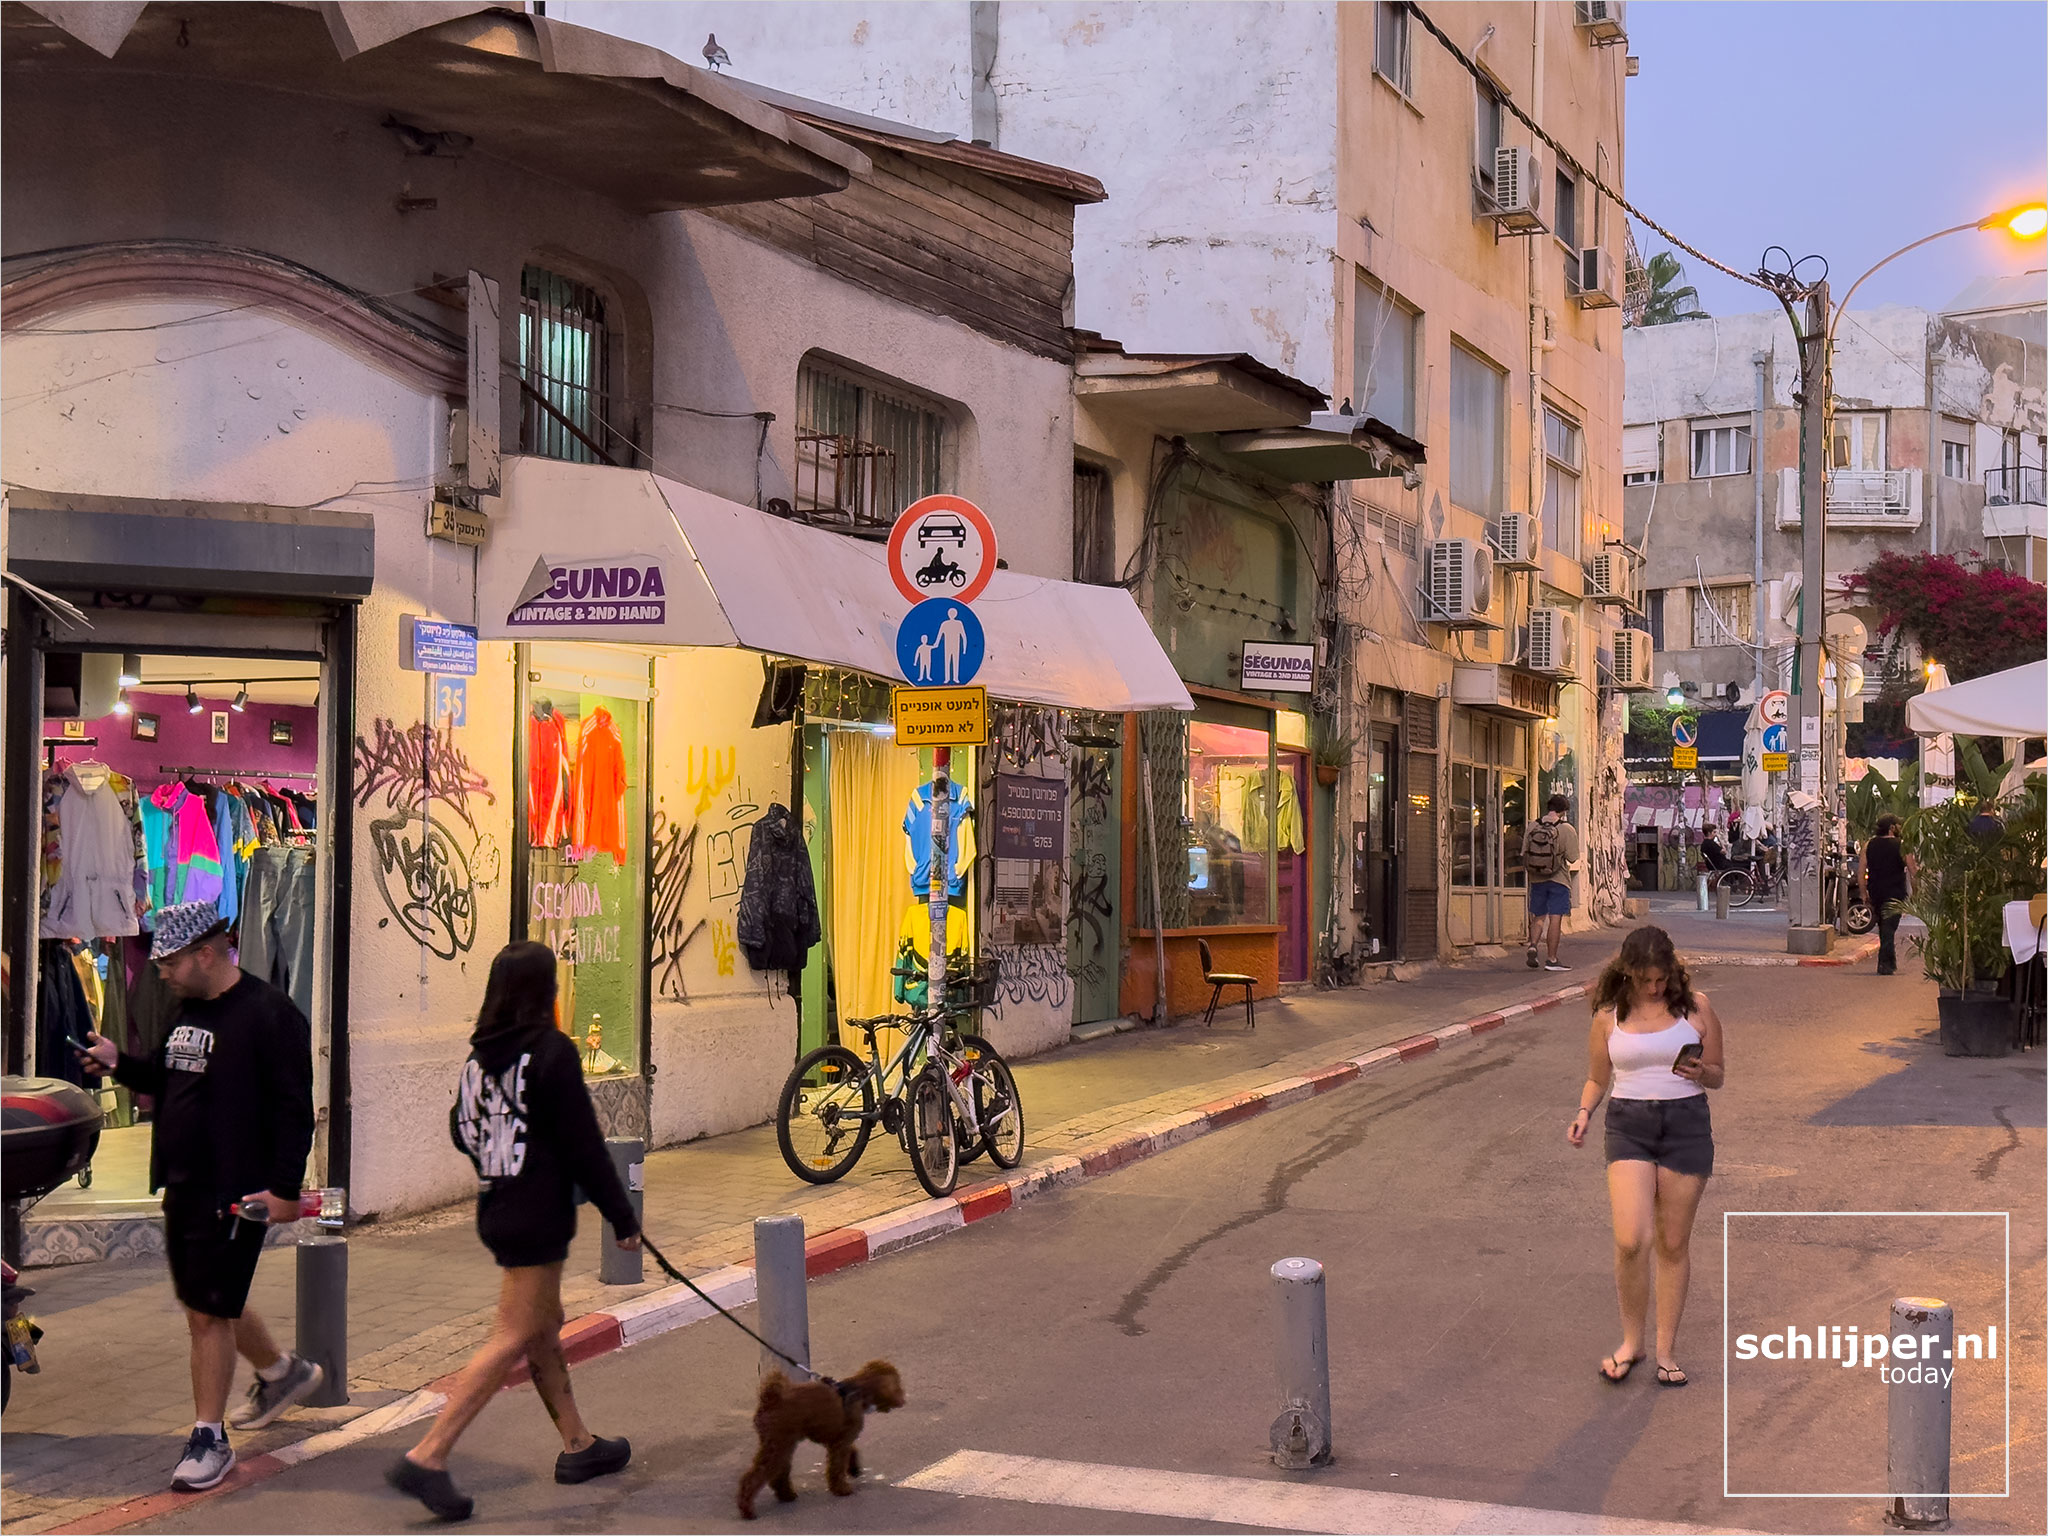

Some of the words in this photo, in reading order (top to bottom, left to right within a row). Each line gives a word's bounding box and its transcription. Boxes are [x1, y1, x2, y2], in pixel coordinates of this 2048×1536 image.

[443, 510, 455, 531] 35
[456, 523, 485, 537] לוינסקי
[534, 566, 665, 600] GUNDA
[513, 606, 571, 621] VINTAGE
[575, 606, 585, 621] &
[587, 606, 617, 621] 2ND
[619, 606, 661, 621] HAND
[1244, 655, 1312, 671] SEGUNDA
[1246, 670, 1273, 679] VINTAGE
[1278, 672, 1292, 680] 2ND
[440, 685, 463, 719] 35
[900, 701, 942, 712] אופניים
[946, 697, 980, 711] למעט
[907, 723, 954, 735] ממונעים
[958, 720, 974, 733] לא
[532, 881, 603, 922] SEGUNDA
